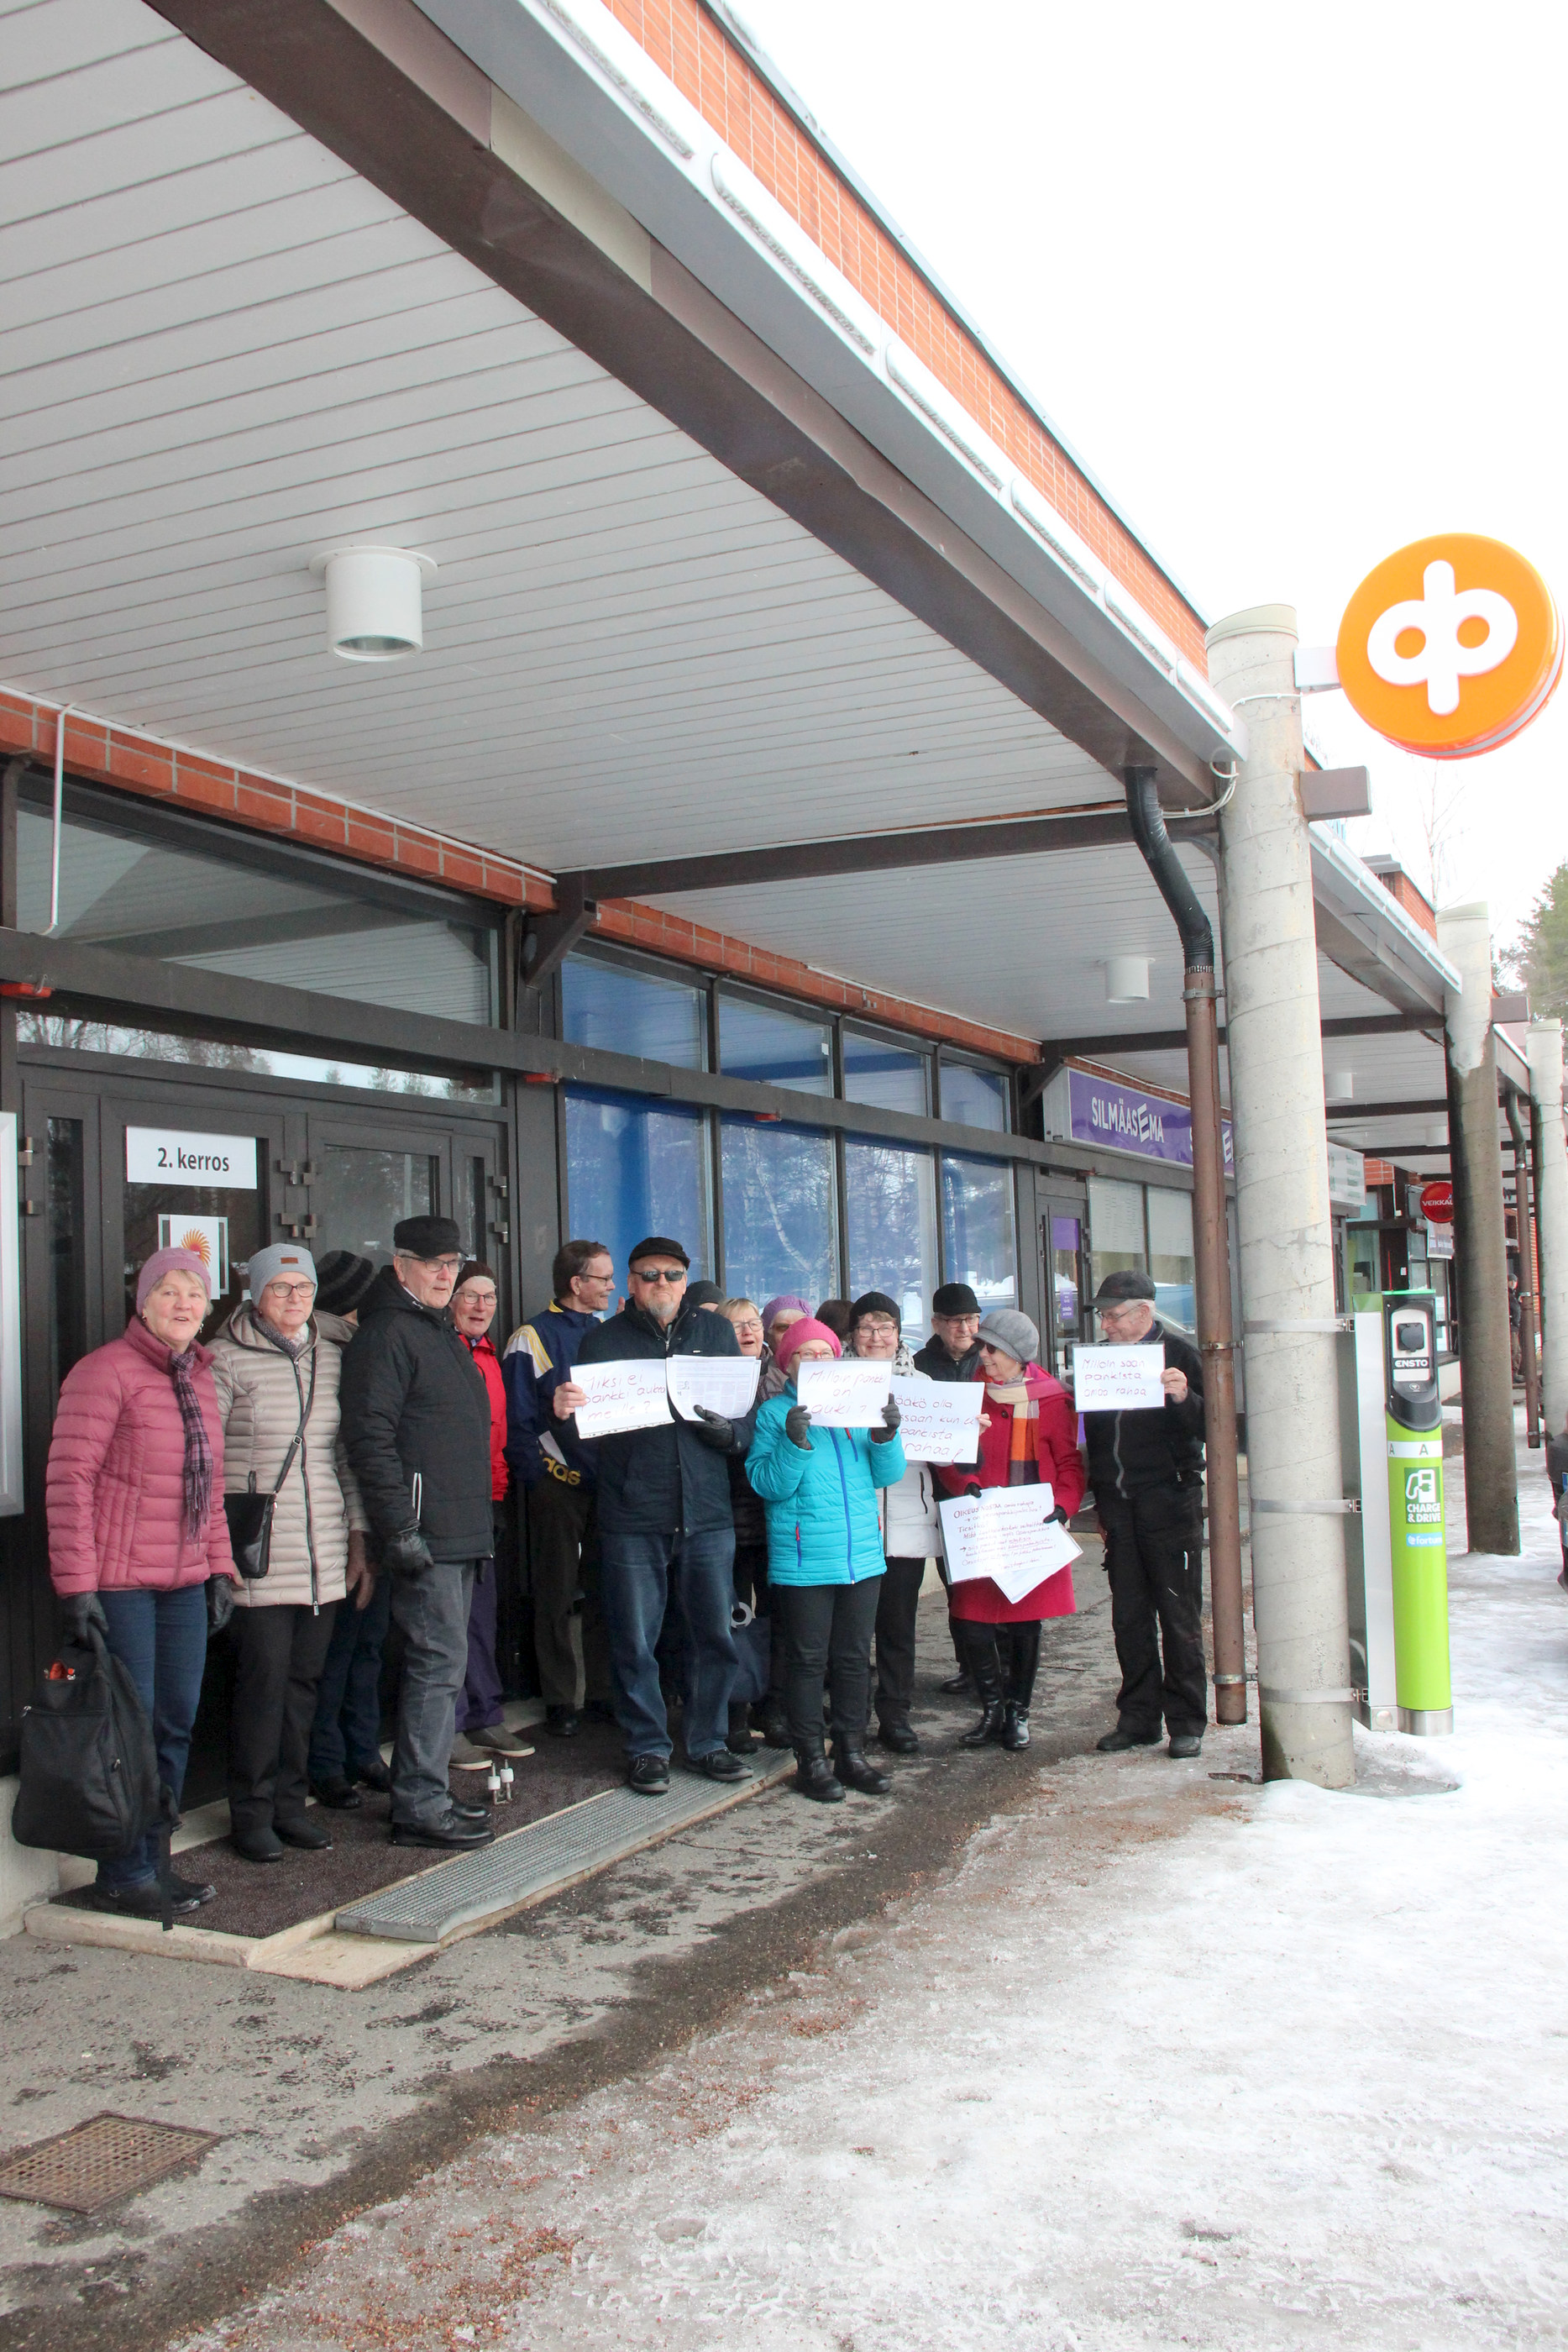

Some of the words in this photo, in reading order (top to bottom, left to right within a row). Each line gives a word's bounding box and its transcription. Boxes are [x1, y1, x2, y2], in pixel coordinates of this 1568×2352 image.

[1092, 1097, 1164, 1142] SILMÄASEMA
[158, 1147, 173, 1168] 2.
[178, 1147, 230, 1172] kerros
[1422, 1199, 1453, 1207] VEIKKA
[1082, 1358, 1115, 1369] Milloin
[1394, 1359, 1429, 1368] ENSTO
[583, 1375, 622, 1390] Miksi
[627, 1368, 644, 1385] ei
[807, 1369, 851, 1384] Milloin
[1084, 1371, 1142, 1384] pankista
[833, 1389, 852, 1397] on
[1115, 1387, 1148, 1396] rahaa
[811, 1403, 852, 1415] auki
[932, 1399, 953, 1409] olla
[1389, 1443, 1396, 1455] A
[1419, 1443, 1429, 1456] A
[1407, 1503, 1441, 1513] CHARGE
[1408, 1513, 1415, 1523] &
[1416, 1512, 1441, 1523] DRIVE
[1416, 1536, 1443, 1545] fortum
